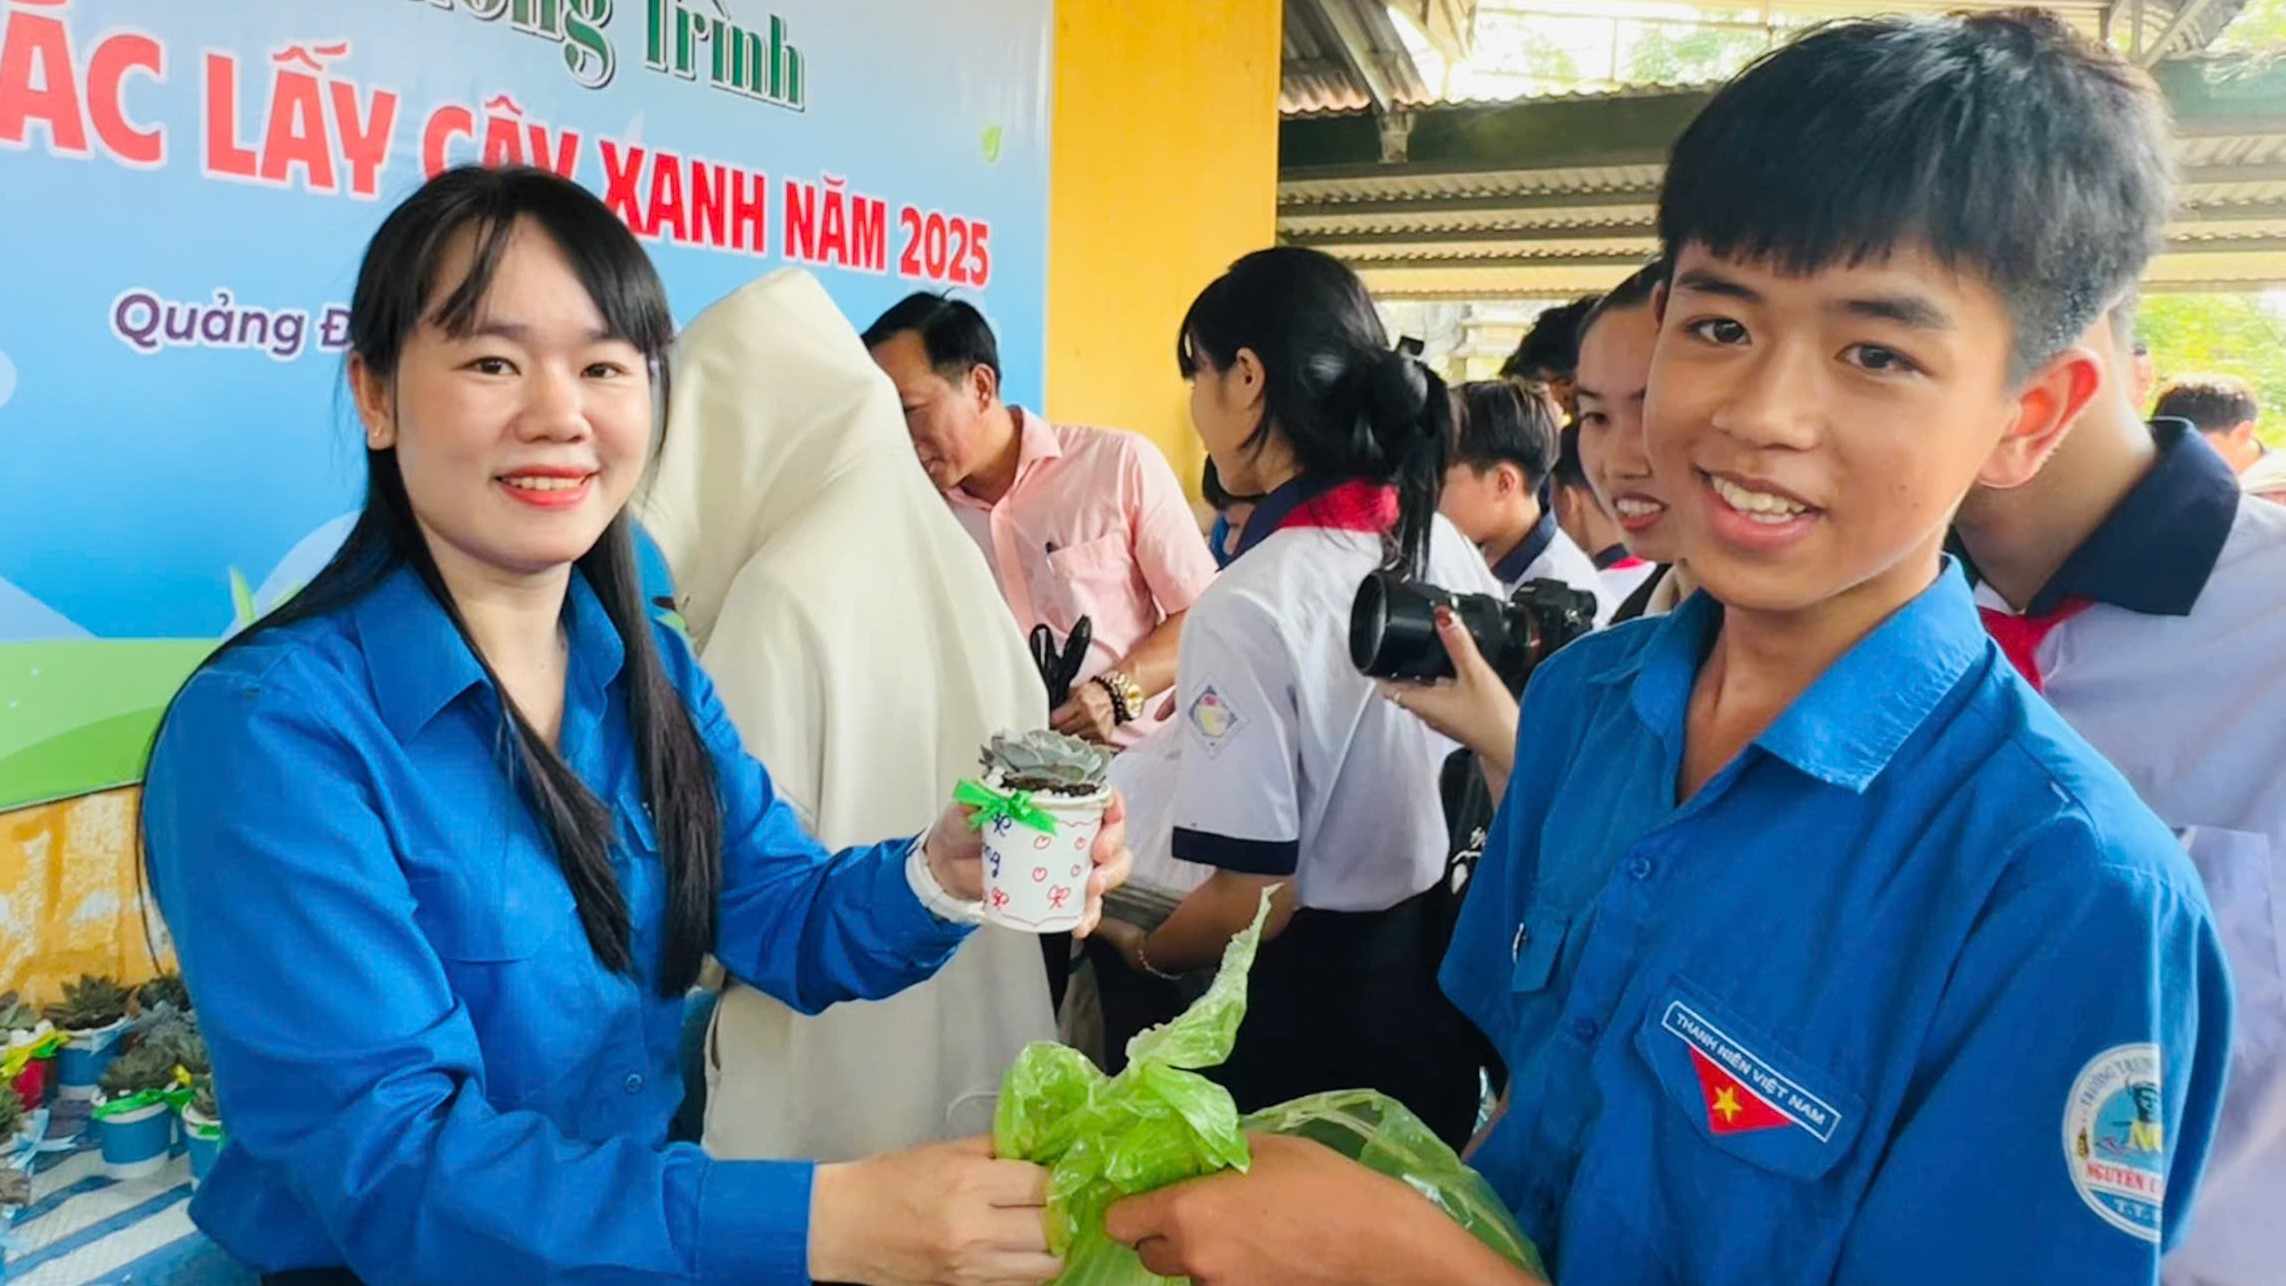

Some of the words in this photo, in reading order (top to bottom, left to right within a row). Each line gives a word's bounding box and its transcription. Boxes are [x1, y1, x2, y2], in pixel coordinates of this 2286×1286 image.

[0, 0, 160, 162] ÁC
[207, 43, 397, 194] LẤY
[599, 140, 765, 253] XANH
[785, 174, 886, 270] NĂM
[901, 207, 989, 287] 2025
[115, 293, 305, 356] Quảng
[1676, 1012, 1719, 1051] THANH
[1717, 1044, 1752, 1076] NIÊN
[1753, 1068, 1789, 1098] VIỆT
[1787, 1093, 1826, 1126] NAM
